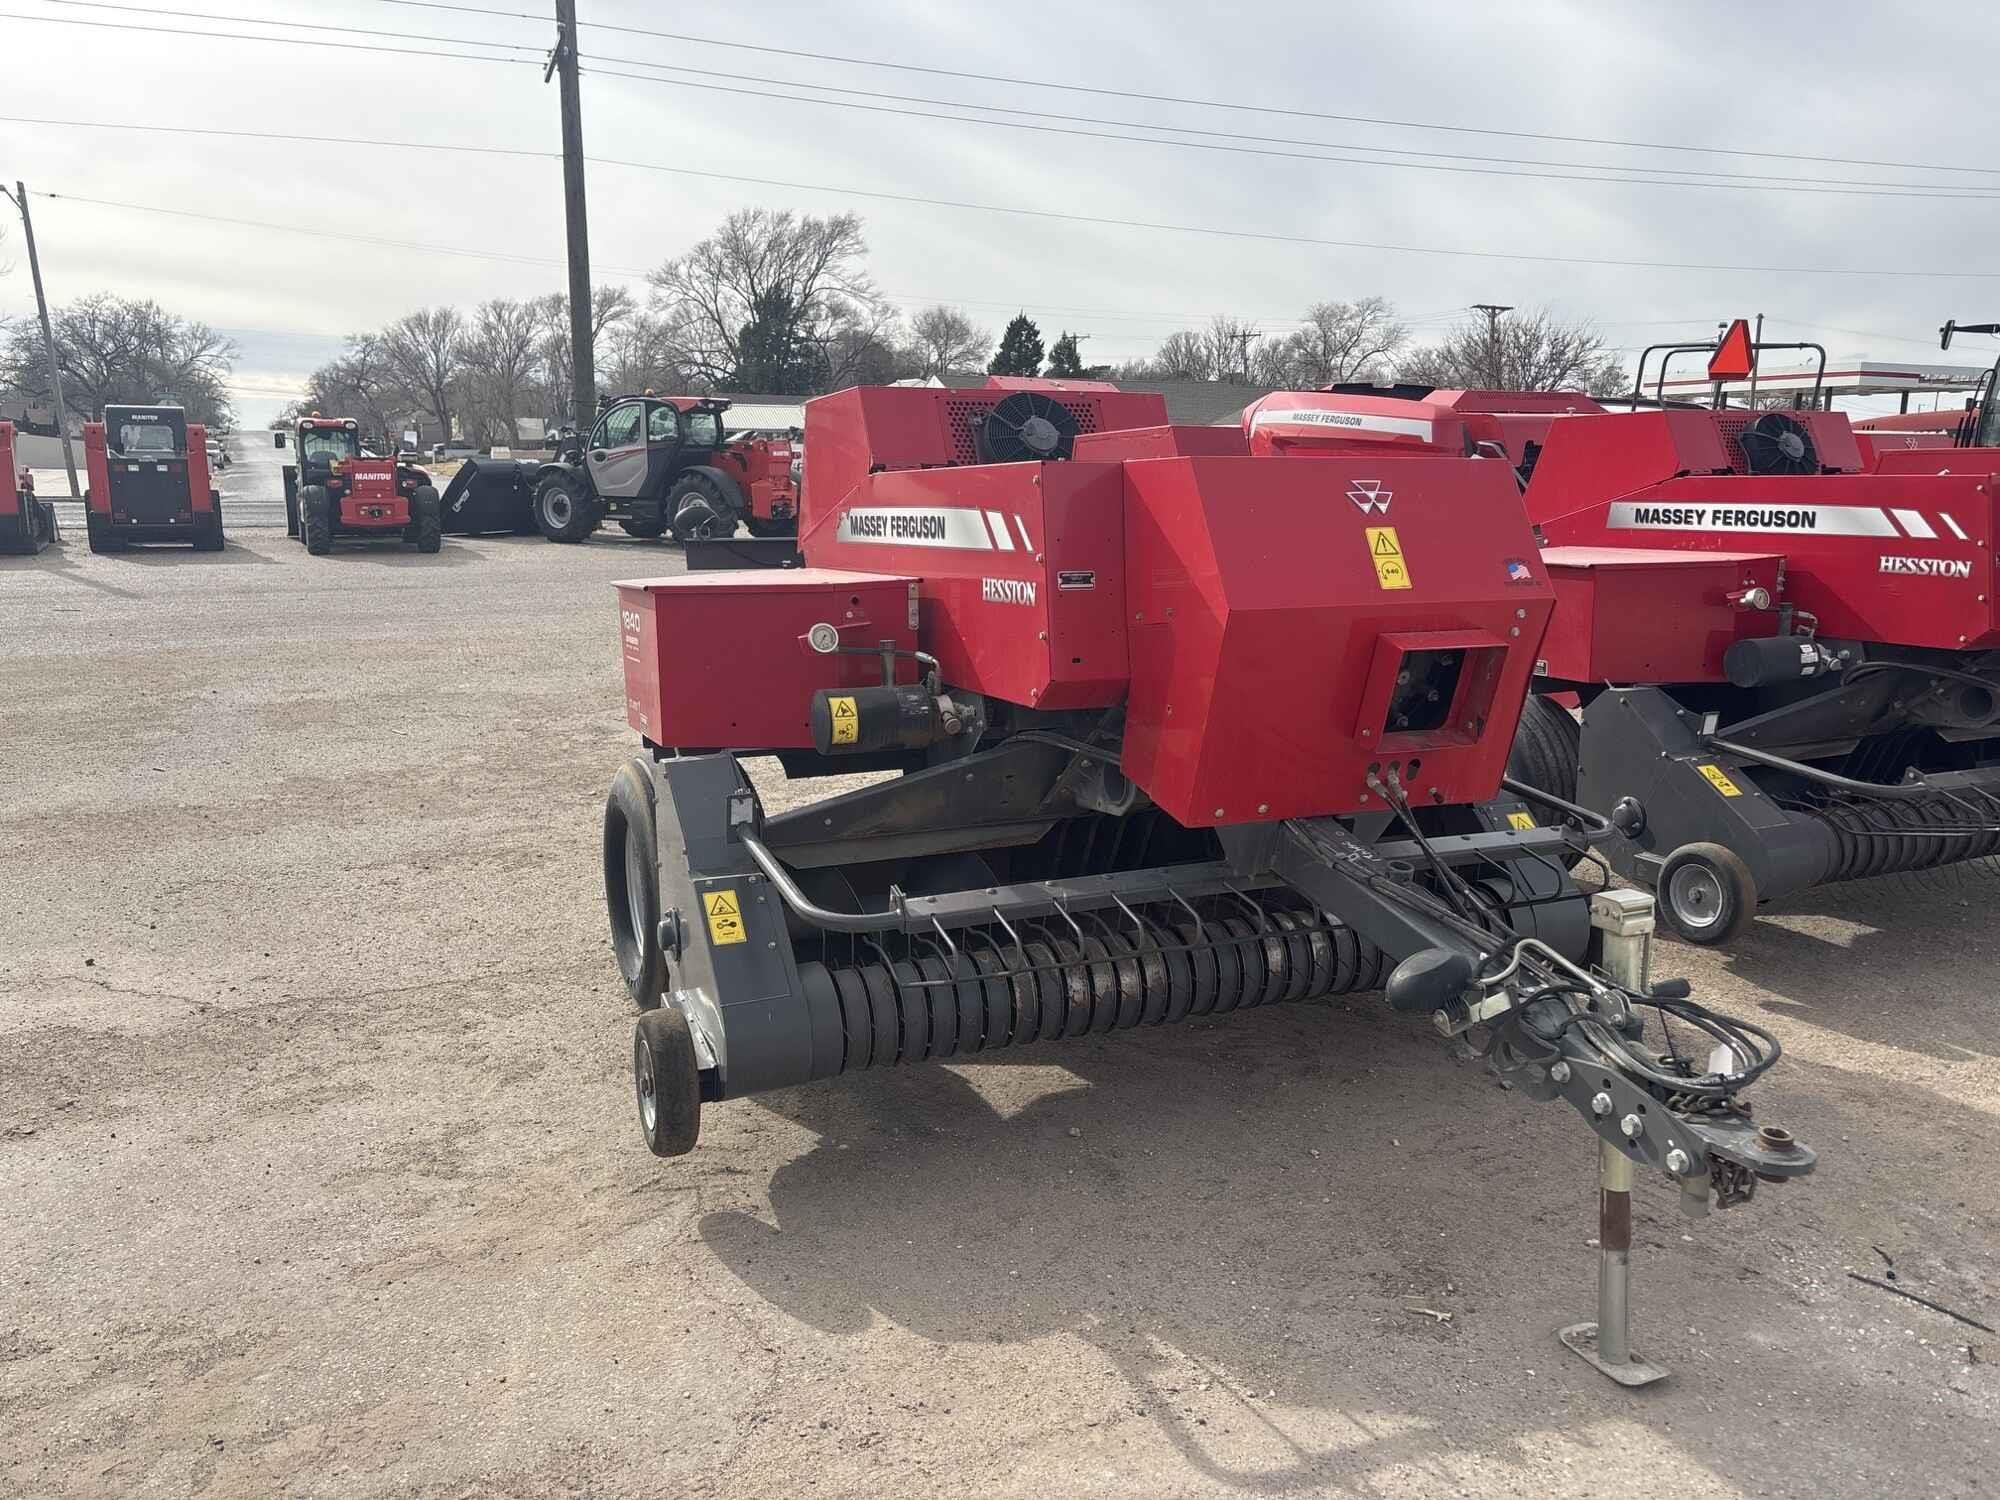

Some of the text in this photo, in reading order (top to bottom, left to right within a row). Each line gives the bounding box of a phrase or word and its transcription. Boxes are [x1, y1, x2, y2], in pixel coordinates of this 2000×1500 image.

[1293, 413, 1362, 426] MASSEY FERGUSON
[850, 515, 945, 539] MASSEY FERGUSON
[1635, 508, 1816, 528] MASSEY FERGUSON
[1879, 556, 1972, 578] HESSTON
[982, 577, 1036, 606] HESSTON
